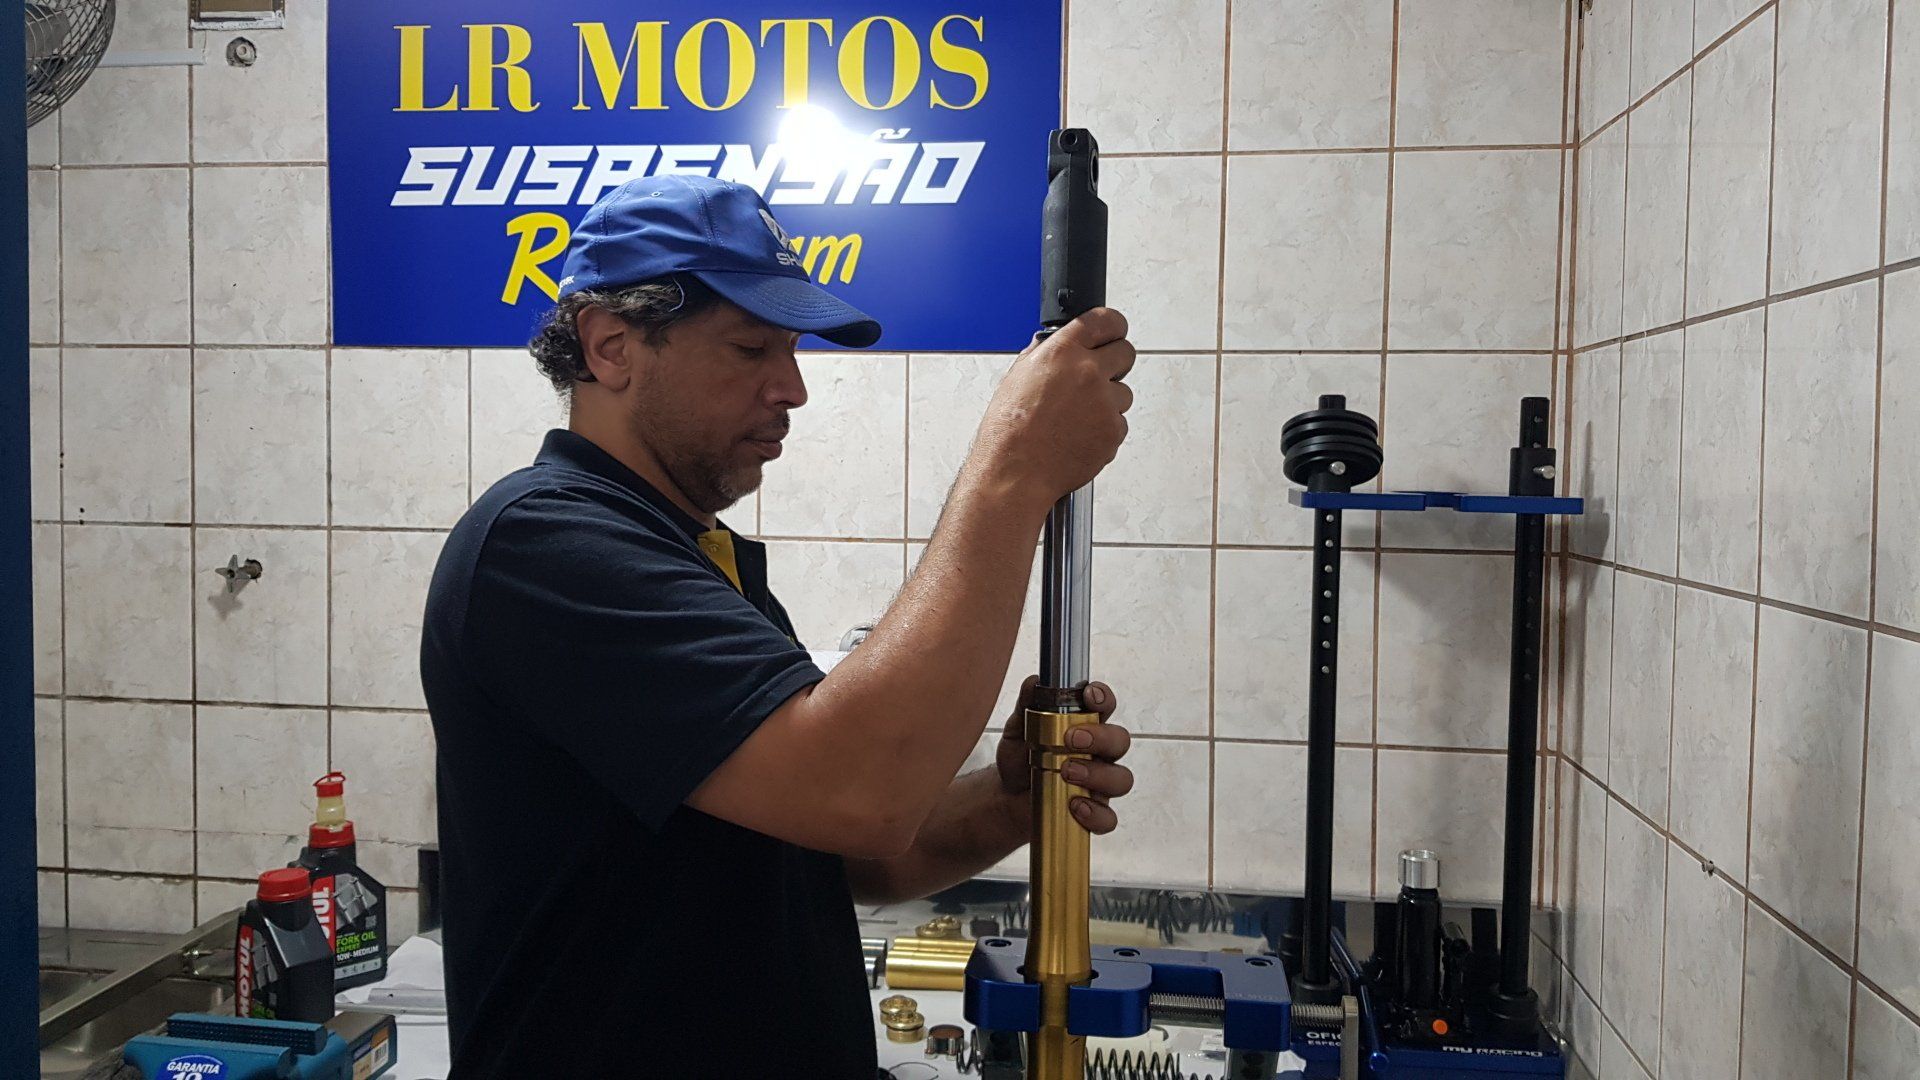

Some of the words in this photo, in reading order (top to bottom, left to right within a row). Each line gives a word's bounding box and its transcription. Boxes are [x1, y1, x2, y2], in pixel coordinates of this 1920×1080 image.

[392, 23, 541, 113] LR
[572, 14, 989, 112] MOTOS
[336, 935, 360, 947] FORK
[361, 931, 377, 941] OIL
[166, 1061, 220, 1074] GARANTIA
